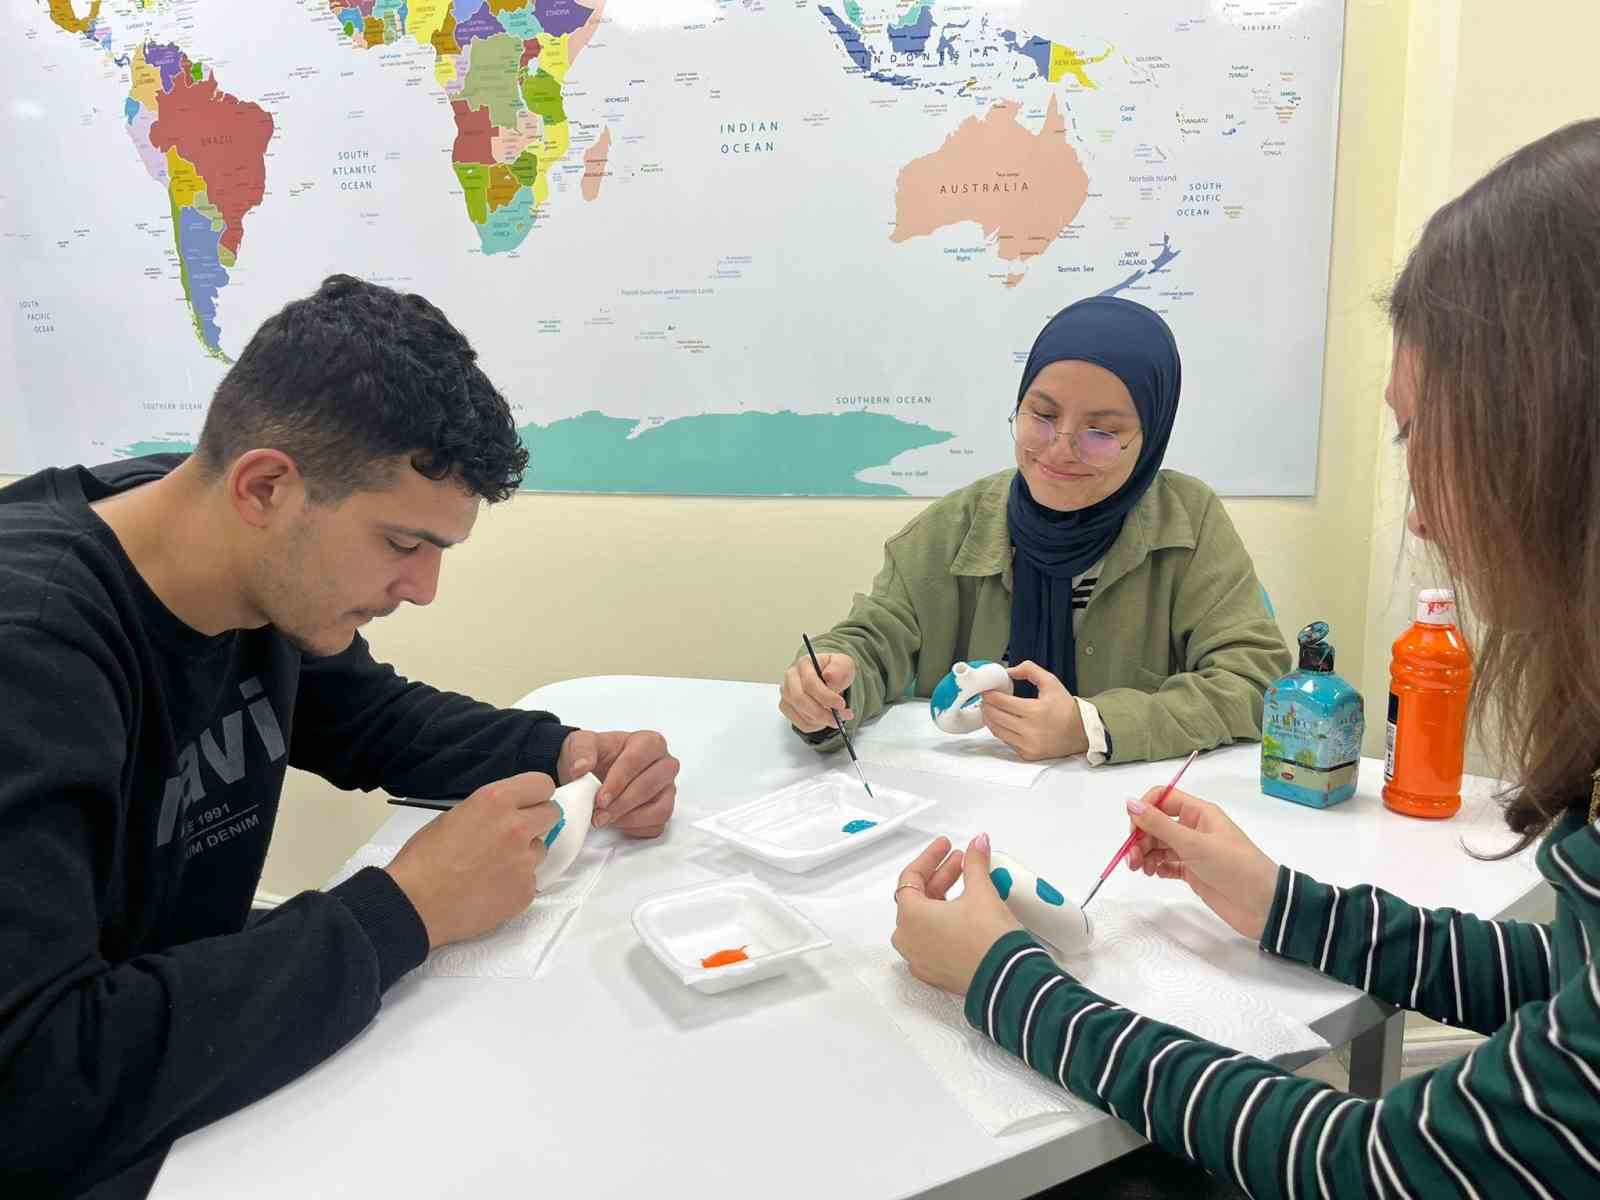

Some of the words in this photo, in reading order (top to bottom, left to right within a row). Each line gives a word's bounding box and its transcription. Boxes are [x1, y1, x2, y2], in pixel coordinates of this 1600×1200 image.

[720, 121, 779, 134] INDIAN
[720, 142, 775, 154] OCEAN
[337, 150, 369, 161] SOUTH
[332, 165, 377, 176] ATLANTIC
[341, 180, 372, 191] OCEAN
[939, 181, 1030, 194] AUSTRALIA
[1189, 182, 1222, 191] SOUTH
[1182, 194, 1222, 202] PACIFIC
[1176, 208, 1210, 217] OCEAN
[836, 396, 890, 405] SOUTHERN
[896, 395, 932, 405] OCEAN
[198, 802, 231, 826] 1991
[206, 814, 260, 848] DENIM
